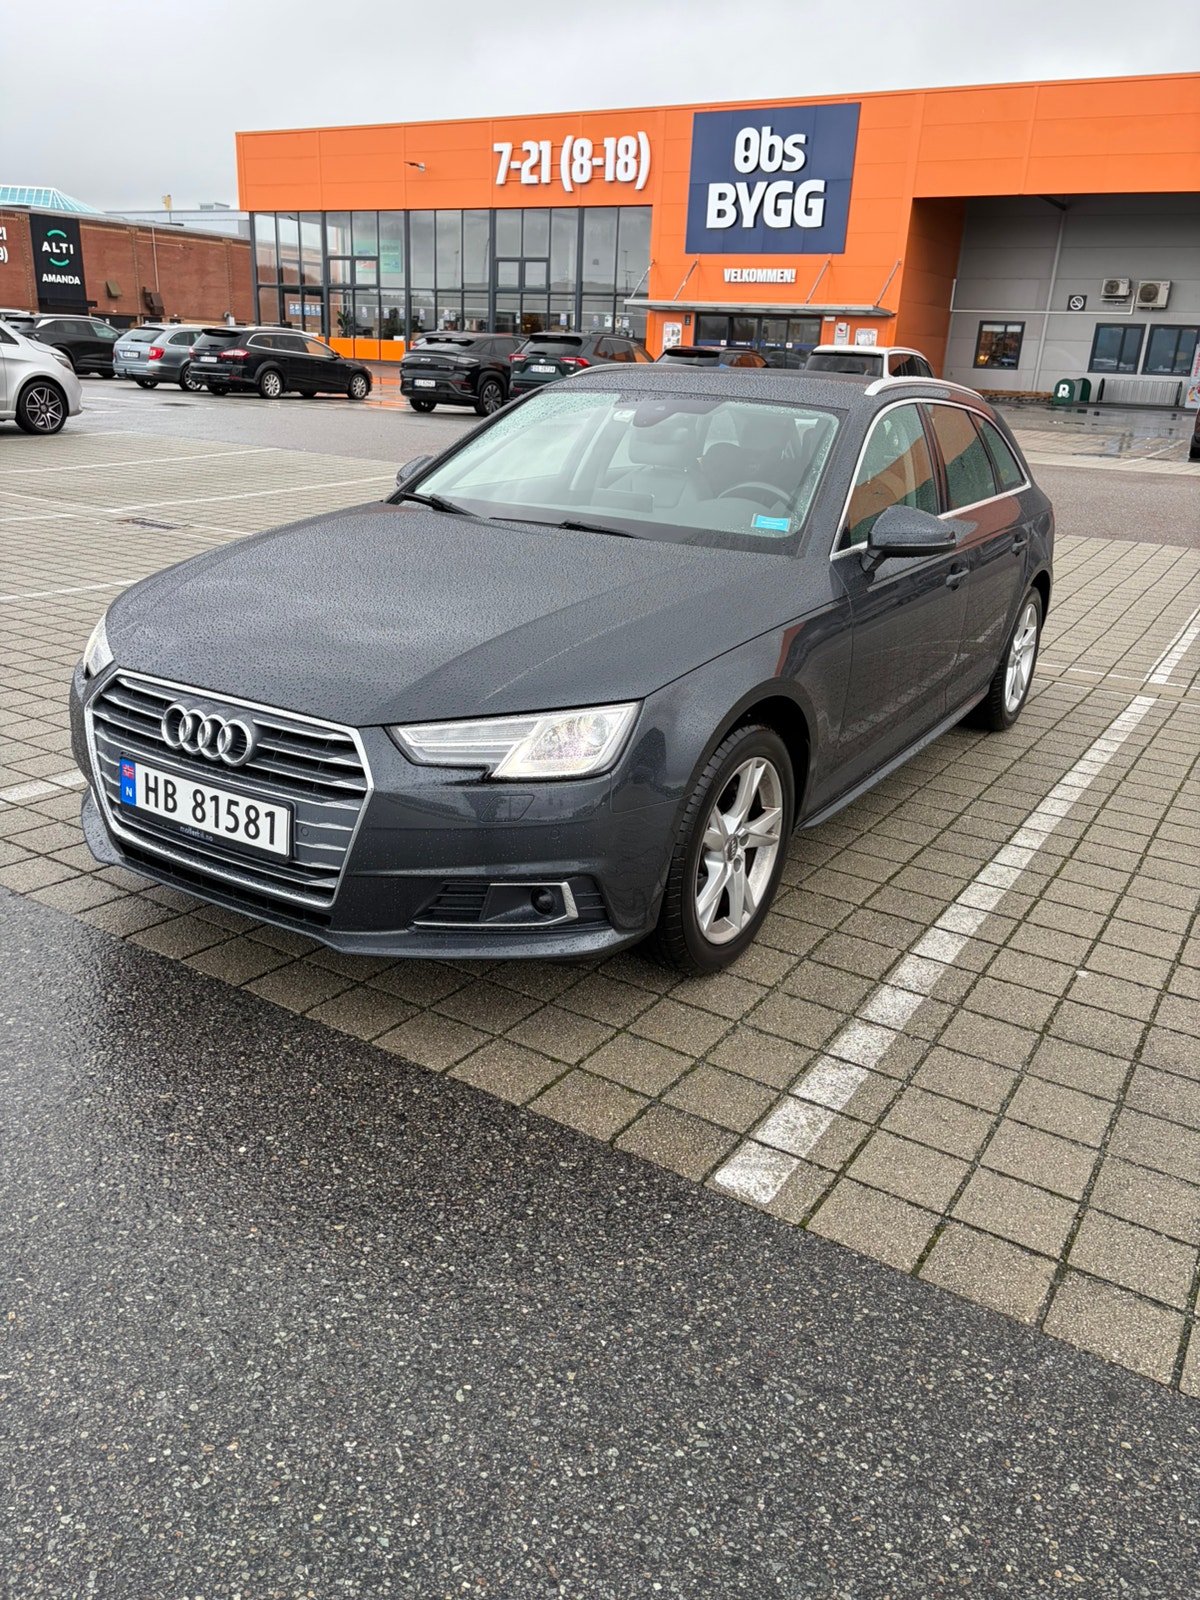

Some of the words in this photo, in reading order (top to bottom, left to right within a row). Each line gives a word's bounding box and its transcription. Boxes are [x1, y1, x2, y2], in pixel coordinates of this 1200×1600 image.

[492, 139, 553, 185] 7-21
[560, 131, 651, 192] (8-18)
[706, 179, 826, 229] BYGG
[42, 241, 74, 254] ALTI
[42, 273, 81, 285] AMANDA
[723, 268, 797, 283] VELKOMMEN!
[125, 786, 133, 798] N
[144, 772, 178, 813] HB
[192, 789, 276, 845] 81581
